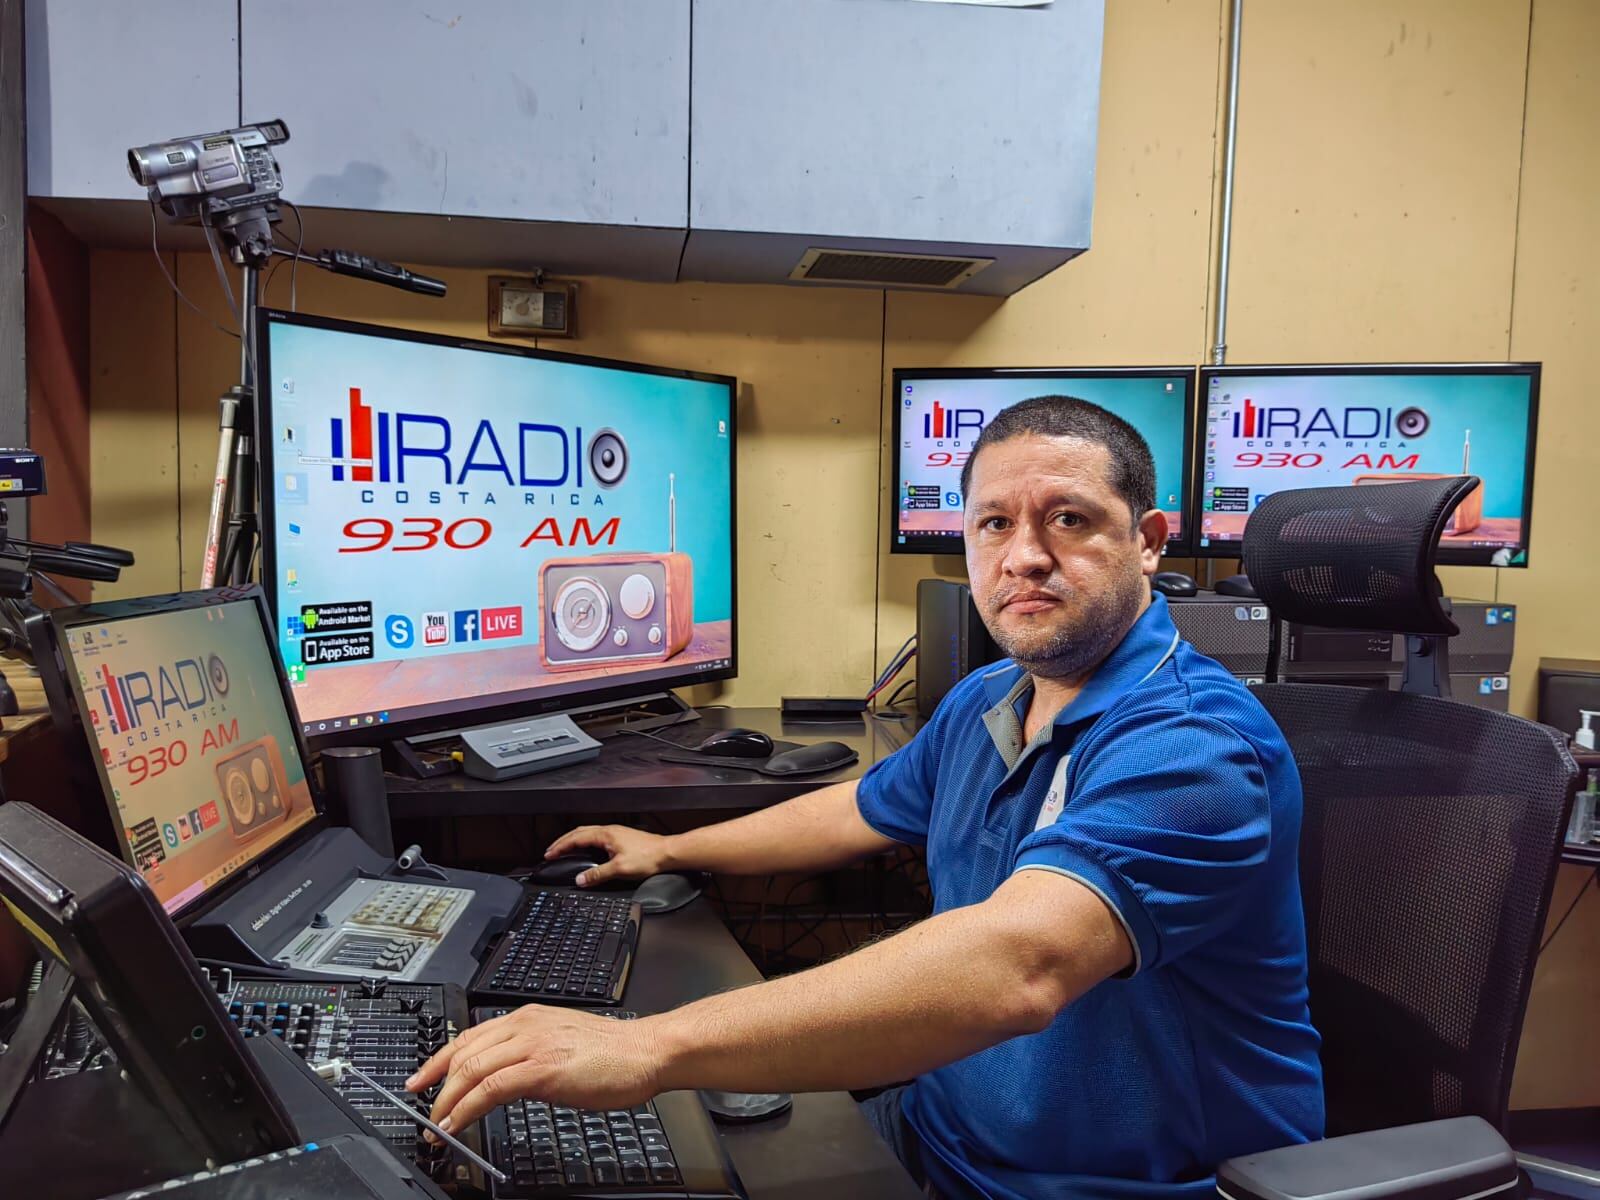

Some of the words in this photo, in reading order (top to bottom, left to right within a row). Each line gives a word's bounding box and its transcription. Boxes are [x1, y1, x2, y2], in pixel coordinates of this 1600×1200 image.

[1233, 453, 1323, 468] 930
[1341, 454, 1420, 469] AM
[361, 490, 496, 505] COSTA
[524, 493, 604, 506] RICA
[338, 518, 493, 553] 930
[520, 517, 621, 548] AM
[319, 606, 348, 615] Available
[318, 616, 347, 626] Android
[348, 615, 371, 623] Market
[427, 615, 445, 626] You
[486, 616, 517, 632] LIVE
[426, 627, 446, 640] Tube
[319, 638, 349, 647] Available
[319, 647, 342, 661] App
[342, 645, 370, 657] Store
[127, 720, 183, 747] COSTA
[192, 704, 227, 723] RICA
[127, 739, 188, 786] 930
[201, 718, 240, 756] AM
